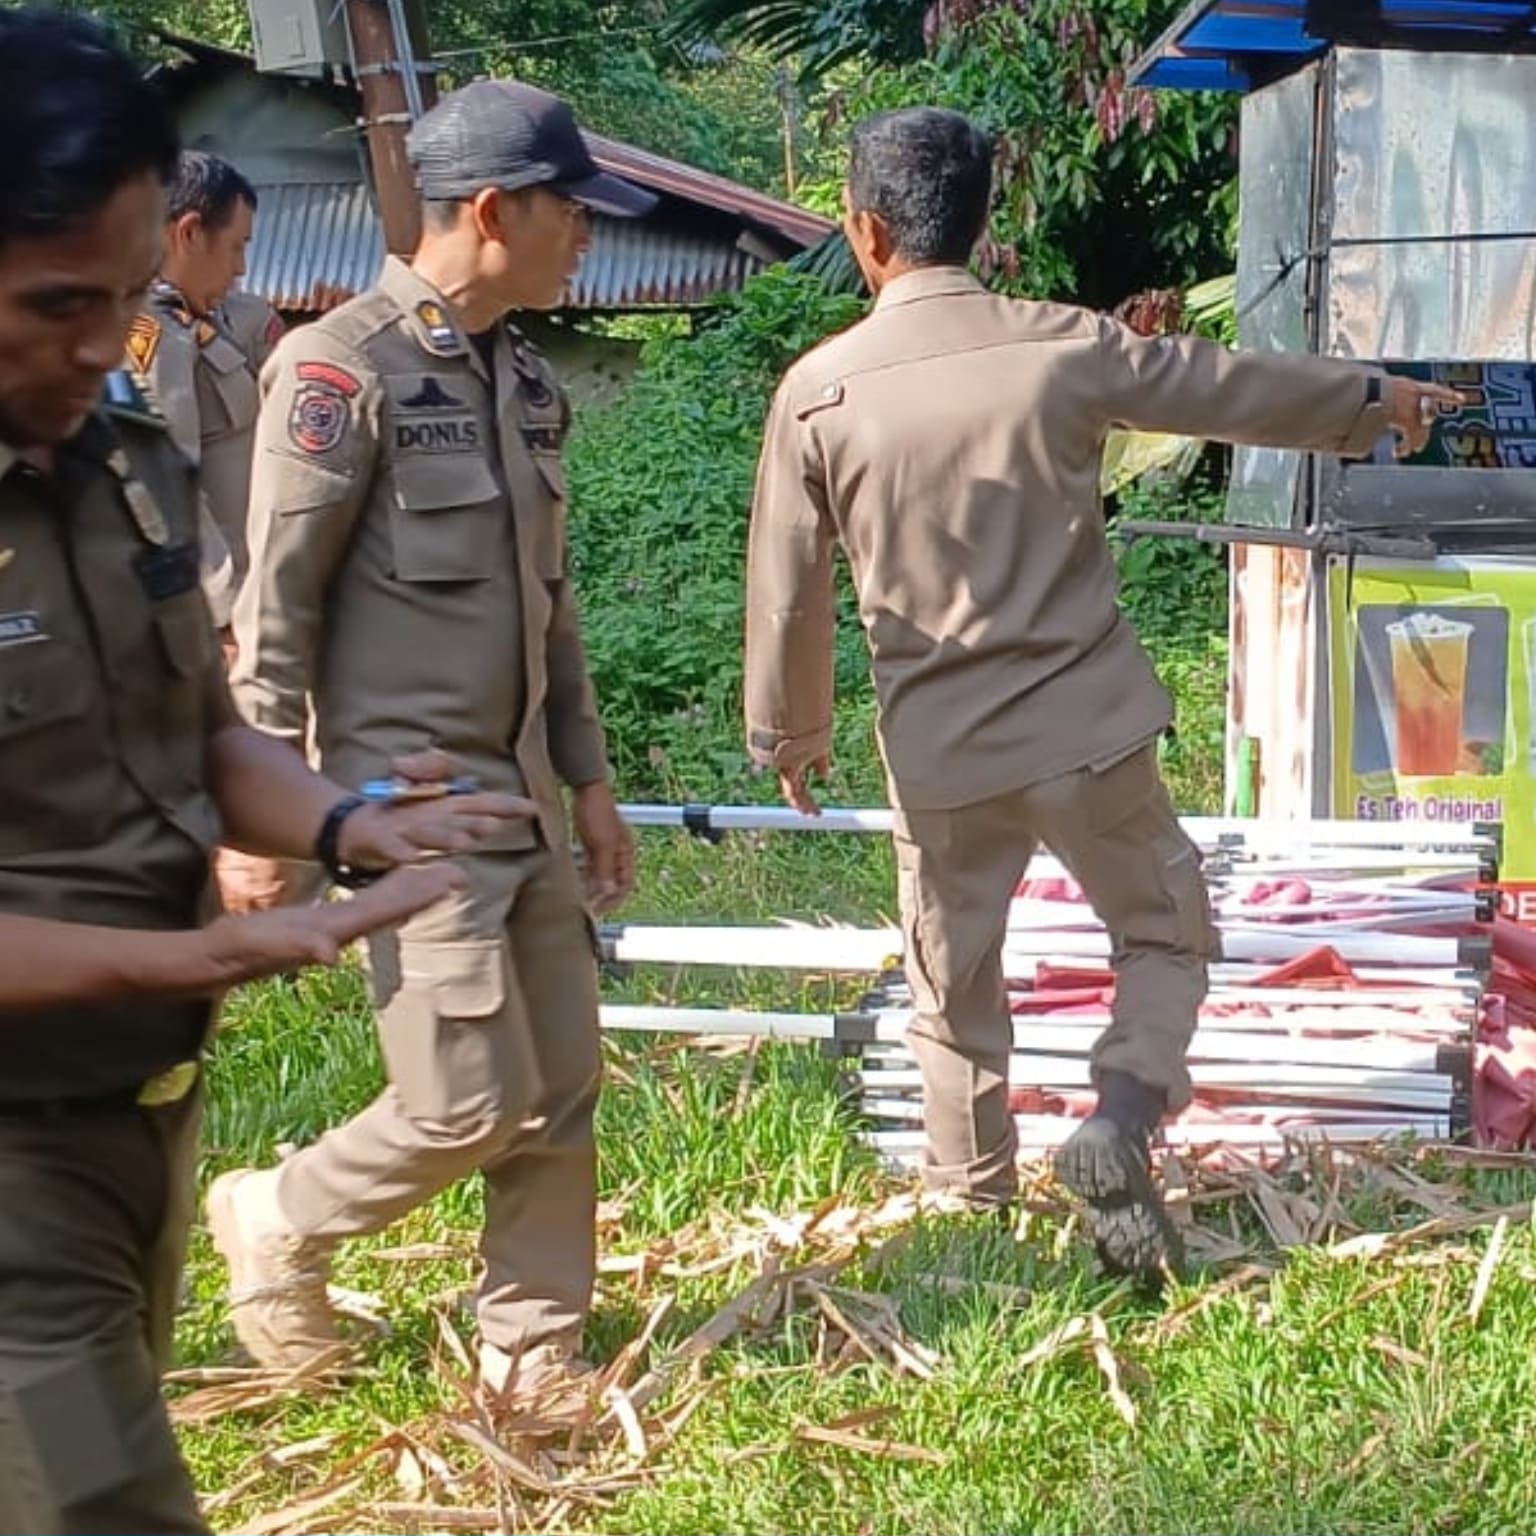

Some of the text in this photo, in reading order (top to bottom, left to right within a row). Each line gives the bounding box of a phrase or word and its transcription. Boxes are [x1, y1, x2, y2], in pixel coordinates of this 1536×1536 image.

[1358, 796, 1501, 822] Es Teh Original
